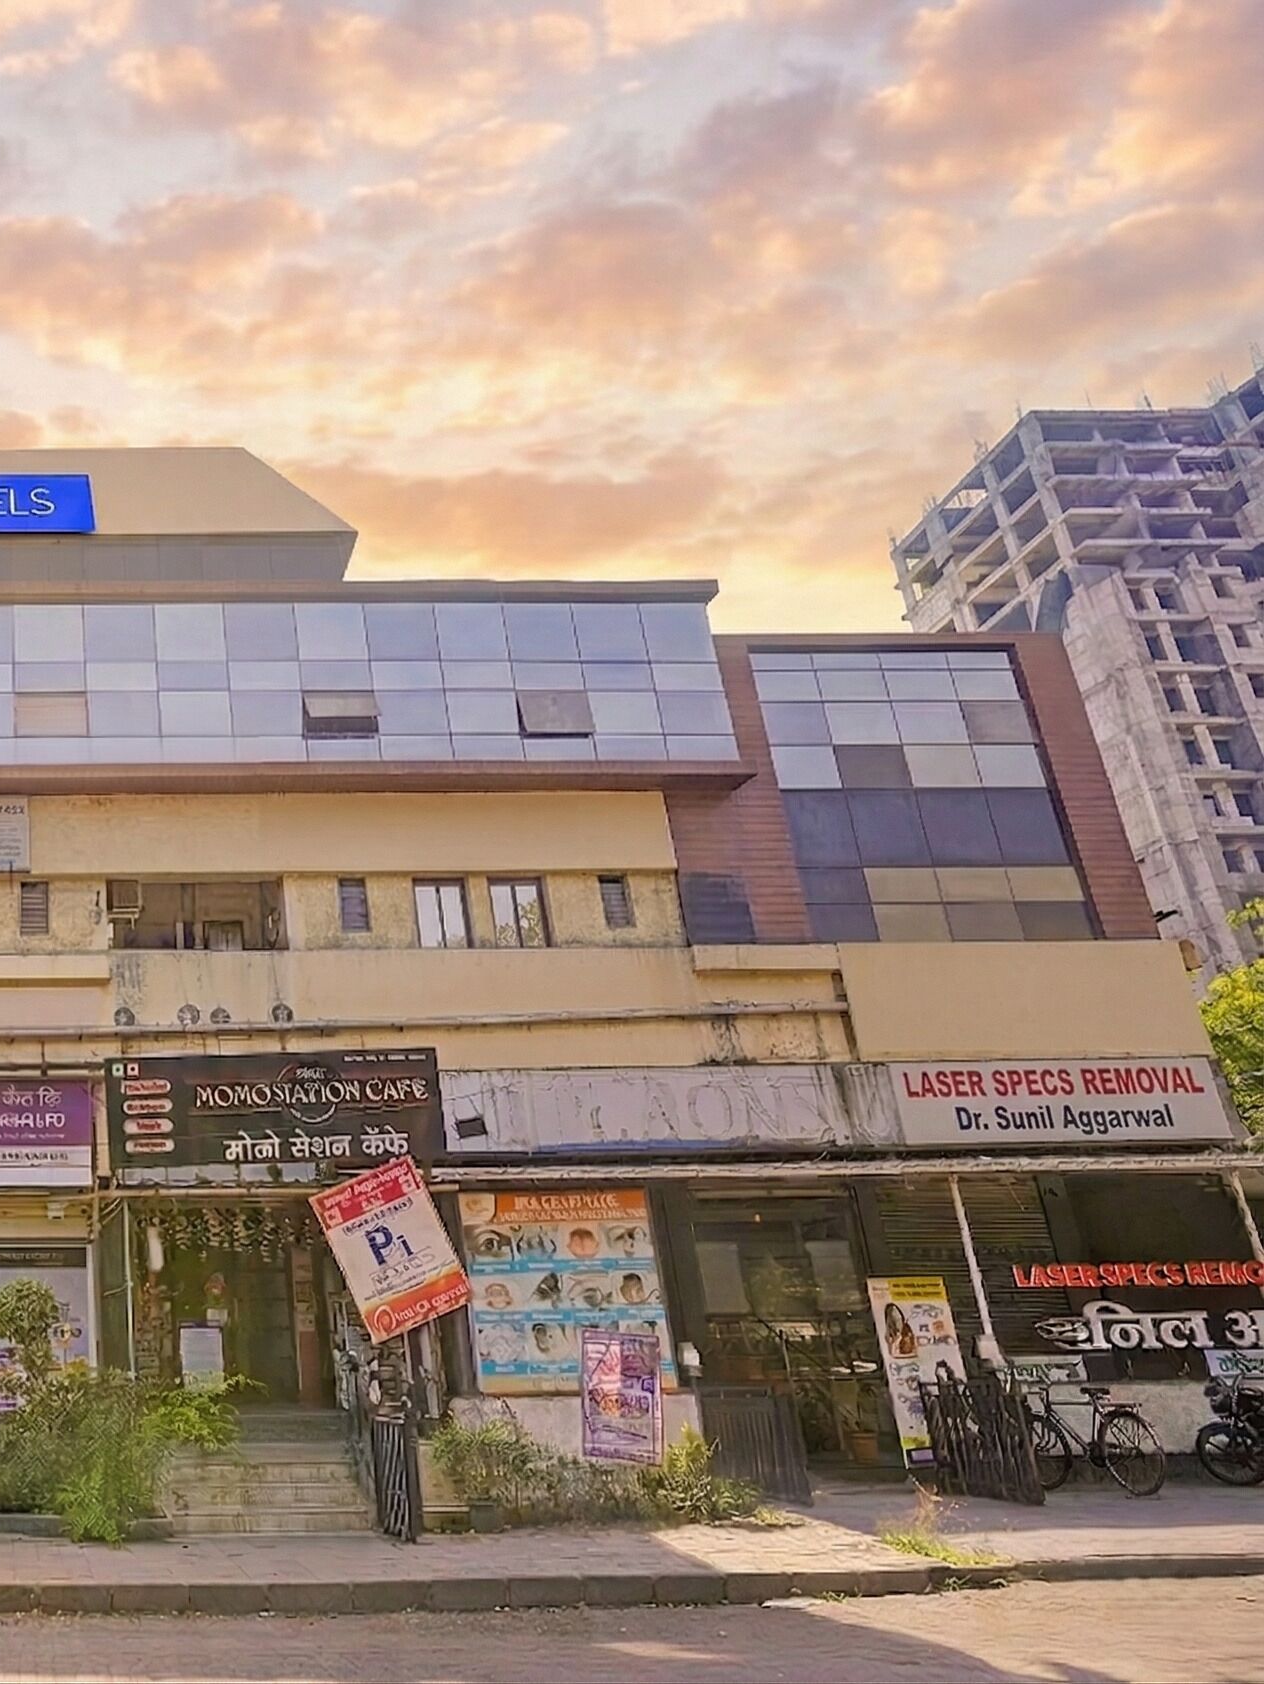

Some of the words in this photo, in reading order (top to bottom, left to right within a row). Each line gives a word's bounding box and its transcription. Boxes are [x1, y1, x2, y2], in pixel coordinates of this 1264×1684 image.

[903, 1070, 986, 1098] LASER
[993, 1068, 1075, 1097] SPECS
[1082, 1066, 1205, 1095] REMOVAL
[955, 1106, 988, 1131] Dr.
[995, 1105, 1054, 1130] Sunil
[1062, 1104, 1175, 1135] Aggarwal
[1012, 1263, 1101, 1288] LASER
[1099, 1262, 1185, 1287] SPECS
